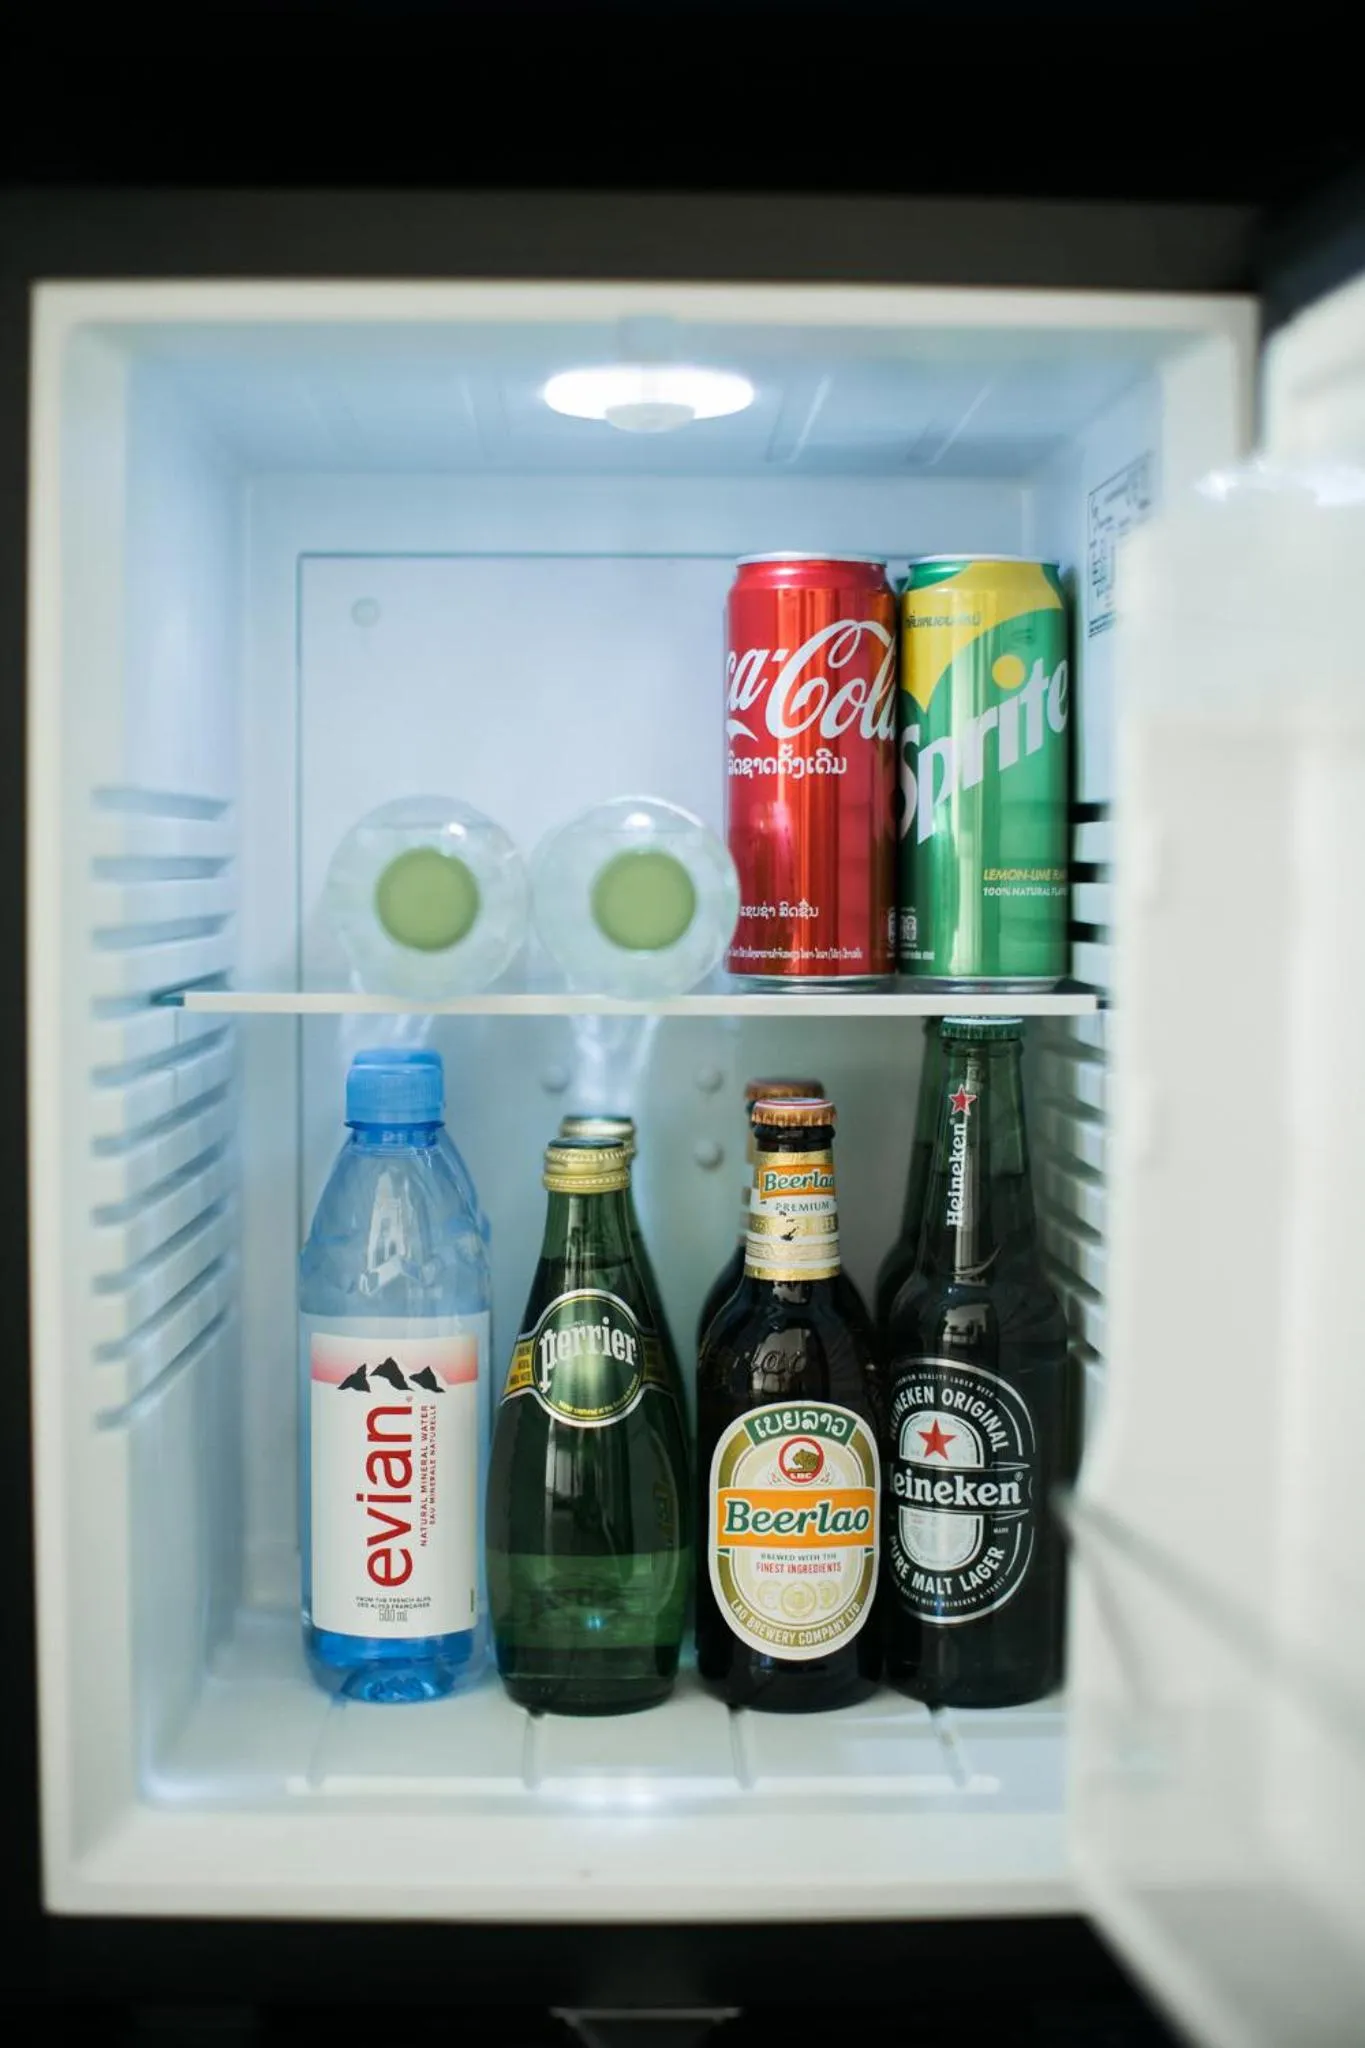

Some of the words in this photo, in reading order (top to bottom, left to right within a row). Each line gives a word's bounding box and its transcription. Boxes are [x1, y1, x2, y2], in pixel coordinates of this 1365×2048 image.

[983, 886, 1010, 897] 100%
[1012, 886, 1051, 897] NATURAL
[946, 1122, 968, 1227] Heineken
[775, 1201, 830, 1212] PREMIUM
[539, 1315, 637, 1394] perrier
[420, 1404, 428, 1441] WATER
[754, 1410, 848, 1438] ເບຍລາວ
[941, 1387, 1009, 1453] ORIGINAL
[420, 1445, 428, 1494] MINERAL
[356, 1405, 413, 1587] evian
[723, 1498, 871, 1535] Beerlao
[420, 1497, 428, 1547] NATURAL
[756, 1562, 784, 1574] FINEST
[787, 1562, 842, 1574] INGREDIENTS
[798, 1553, 820, 1561] WITH
[911, 1571, 953, 1596] MALT
[959, 1546, 1006, 1593] LAGER
[731, 1598, 749, 1620] LAO
[746, 1617, 797, 1645] BREWERY
[798, 1618, 847, 1645] COMPANY
